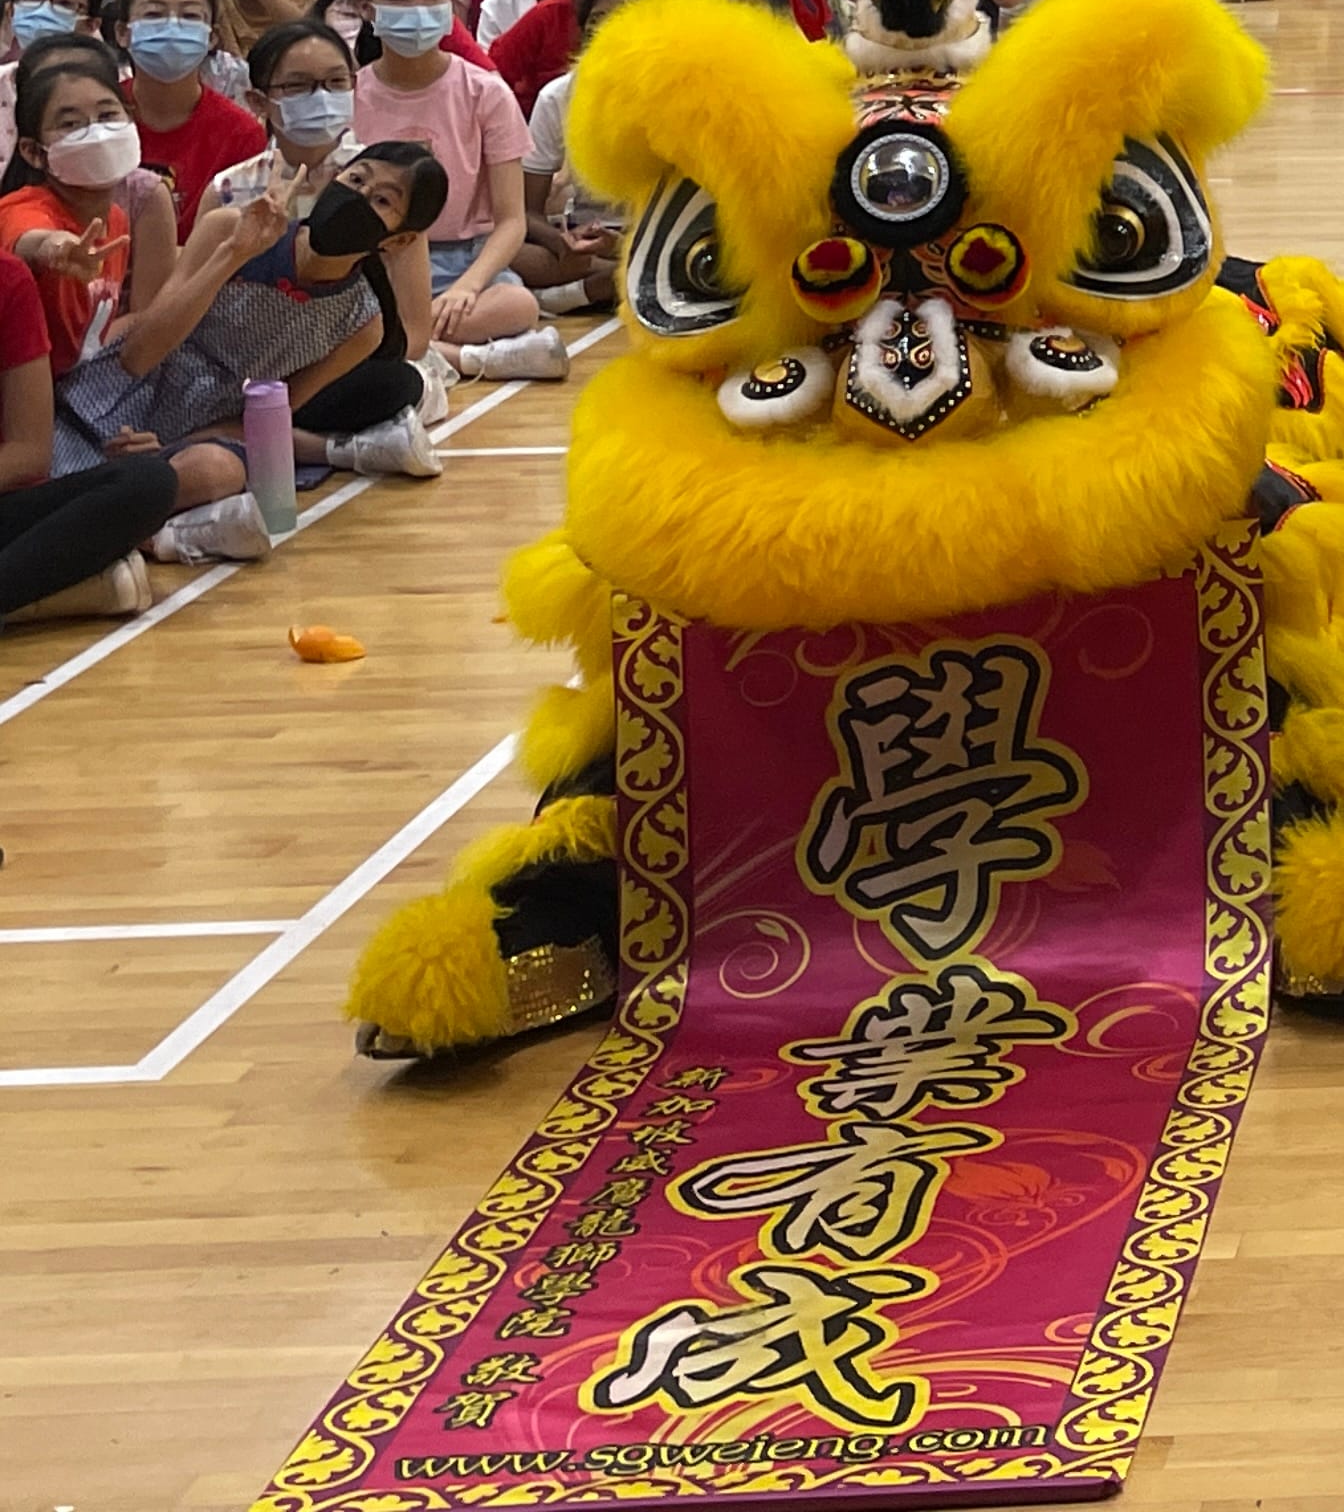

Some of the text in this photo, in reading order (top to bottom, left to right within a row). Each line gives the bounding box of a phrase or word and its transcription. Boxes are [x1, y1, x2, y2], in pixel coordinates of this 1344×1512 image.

[590, 641, 1082, 1428] 學業有成
[397, 1423, 1049, 1479] www.sgweieng.com
